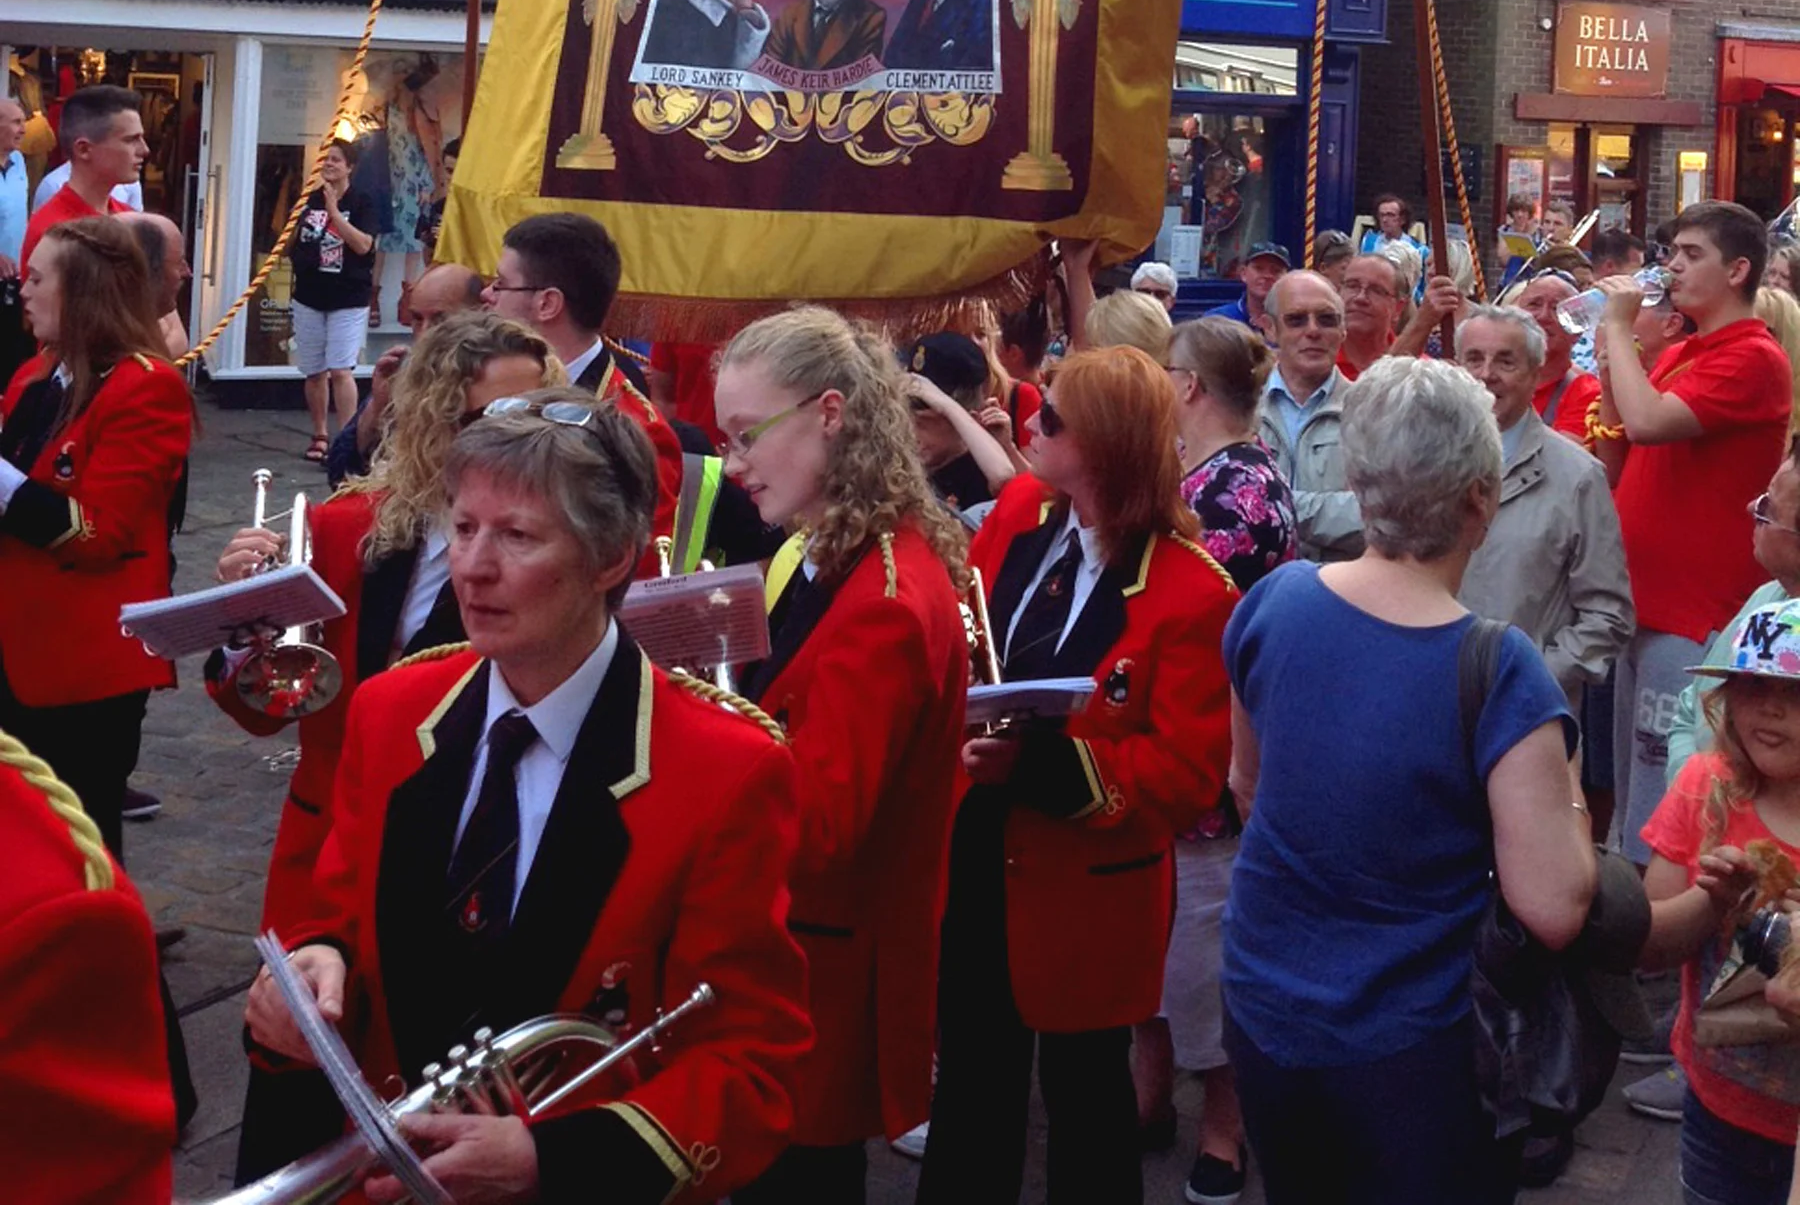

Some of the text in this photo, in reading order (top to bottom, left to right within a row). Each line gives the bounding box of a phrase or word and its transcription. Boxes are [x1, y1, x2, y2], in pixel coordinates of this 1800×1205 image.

[1579, 15, 1650, 43] BELLA
[1574, 44, 1650, 72] ITALIA
[651, 66, 745, 88] LORD SANKEY
[758, 57, 874, 89] JAMES KEIR HARDIE
[886, 72, 994, 91] CLEMENT ATTLEE
[1740, 611, 1792, 661] NY
